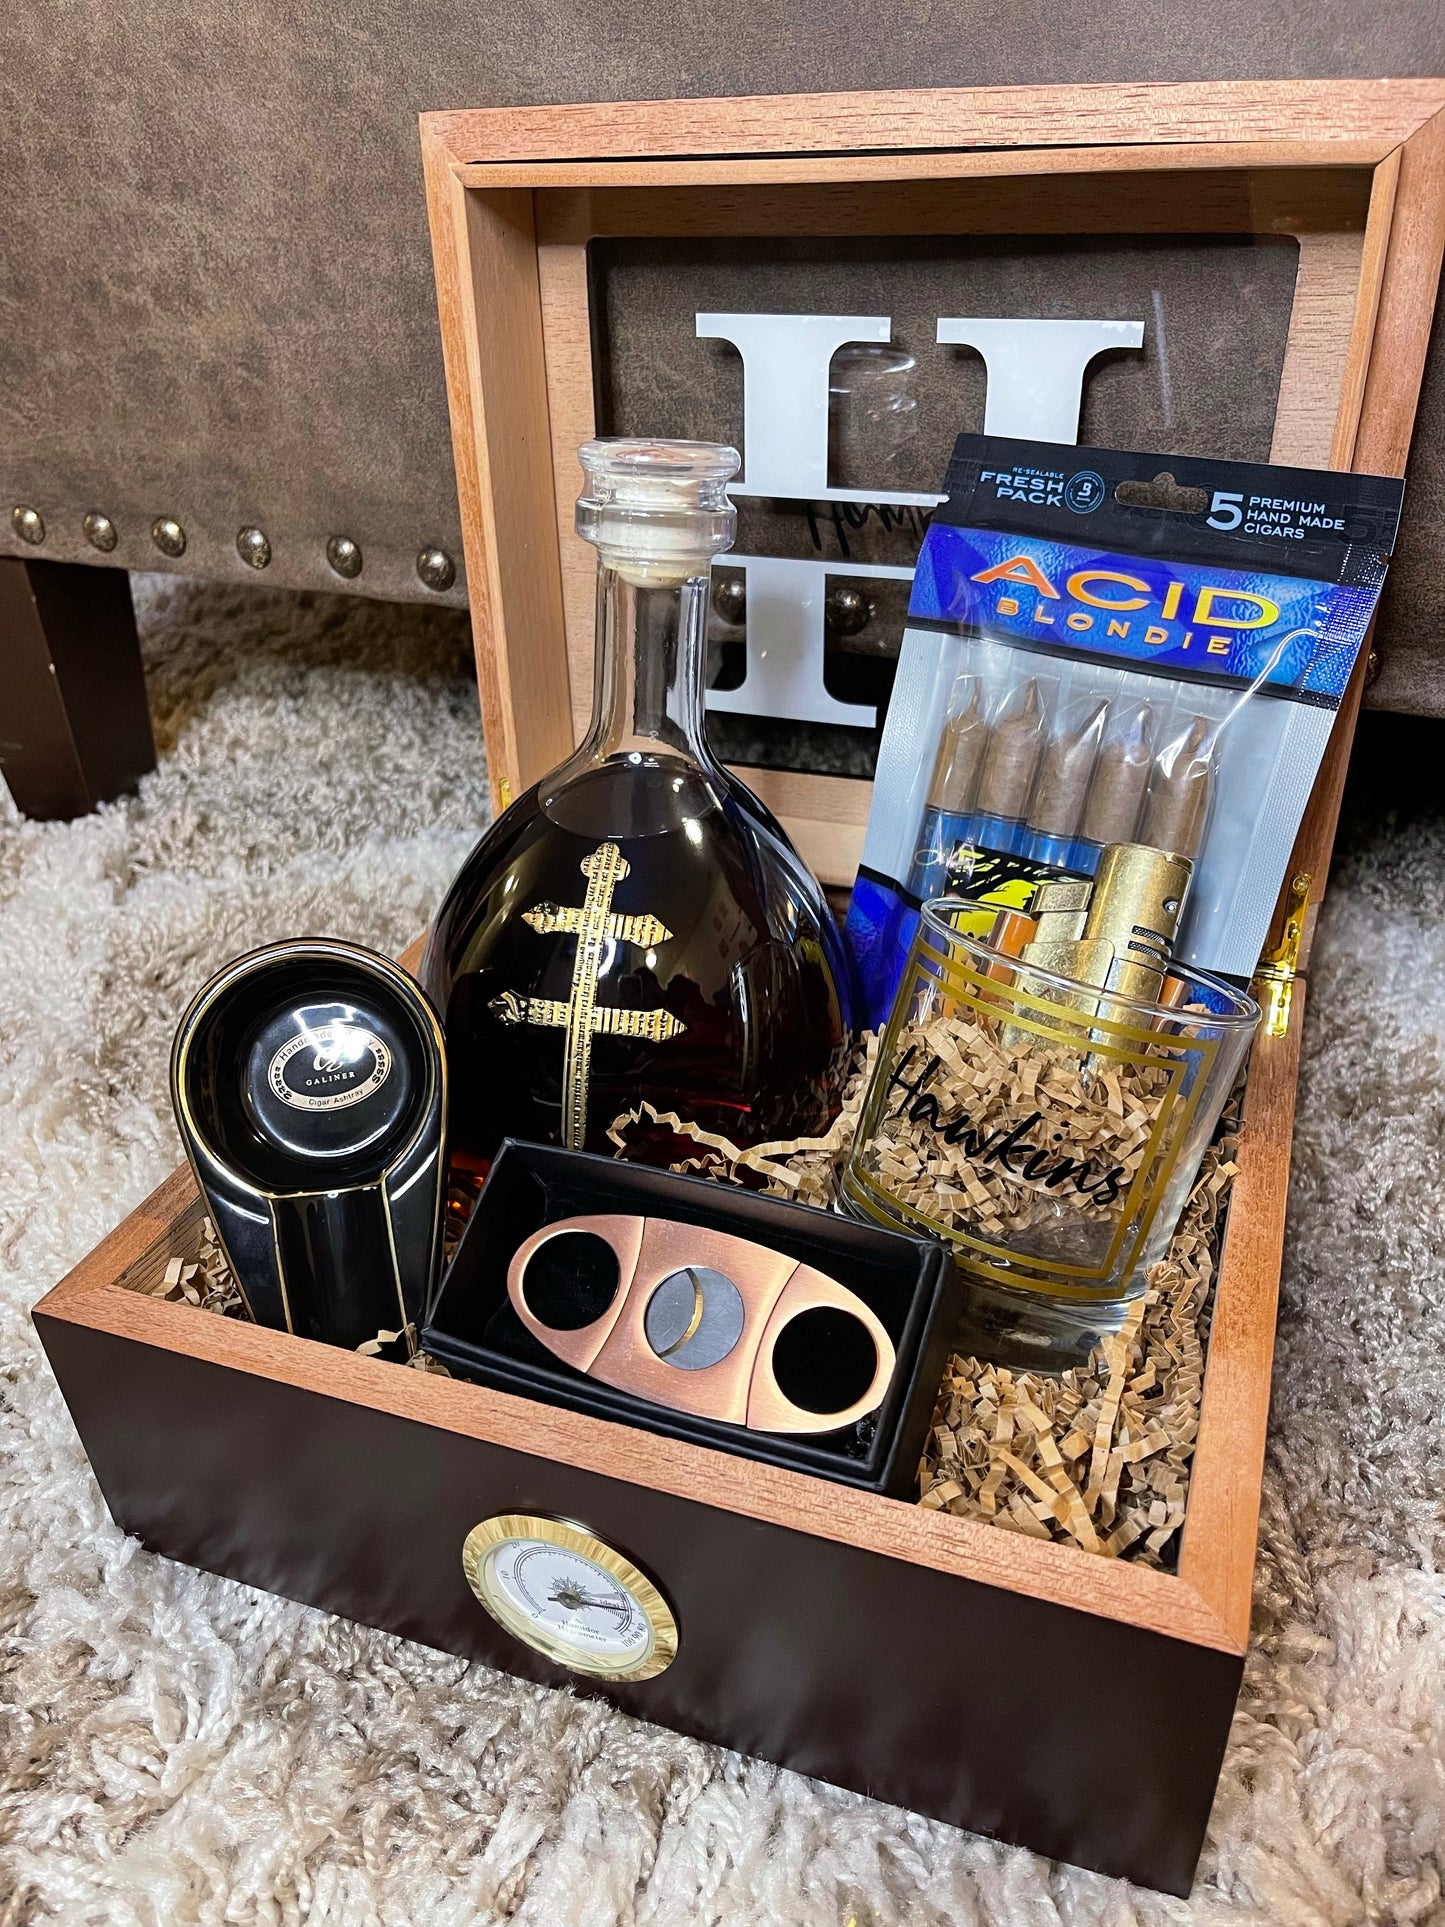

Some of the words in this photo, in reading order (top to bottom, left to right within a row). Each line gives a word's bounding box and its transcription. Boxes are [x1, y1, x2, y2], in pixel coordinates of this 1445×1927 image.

[980, 471, 1065, 493] FRESH
[1012, 466, 1065, 479] RE-SEALABLE
[996, 487, 1063, 507] PACK
[1249, 496, 1326, 515] PREMIUM
[1206, 491, 1244, 531] 5
[1246, 510, 1291, 524] HAND
[1299, 516, 1346, 531] MADE
[1244, 523, 1305, 540] CIGARS
[970, 555, 1280, 630] ACID
[996, 599, 1234, 656] BLONDIE
[279, 1030, 333, 1062] Handmde
[305, 1071, 356, 1087] GALINER
[308, 1098, 331, 1108] Cigar
[333, 1089, 364, 1105] Ashtray
[886, 1044, 1134, 1206] Hawkins
[621, 1638, 635, 1648] 100
